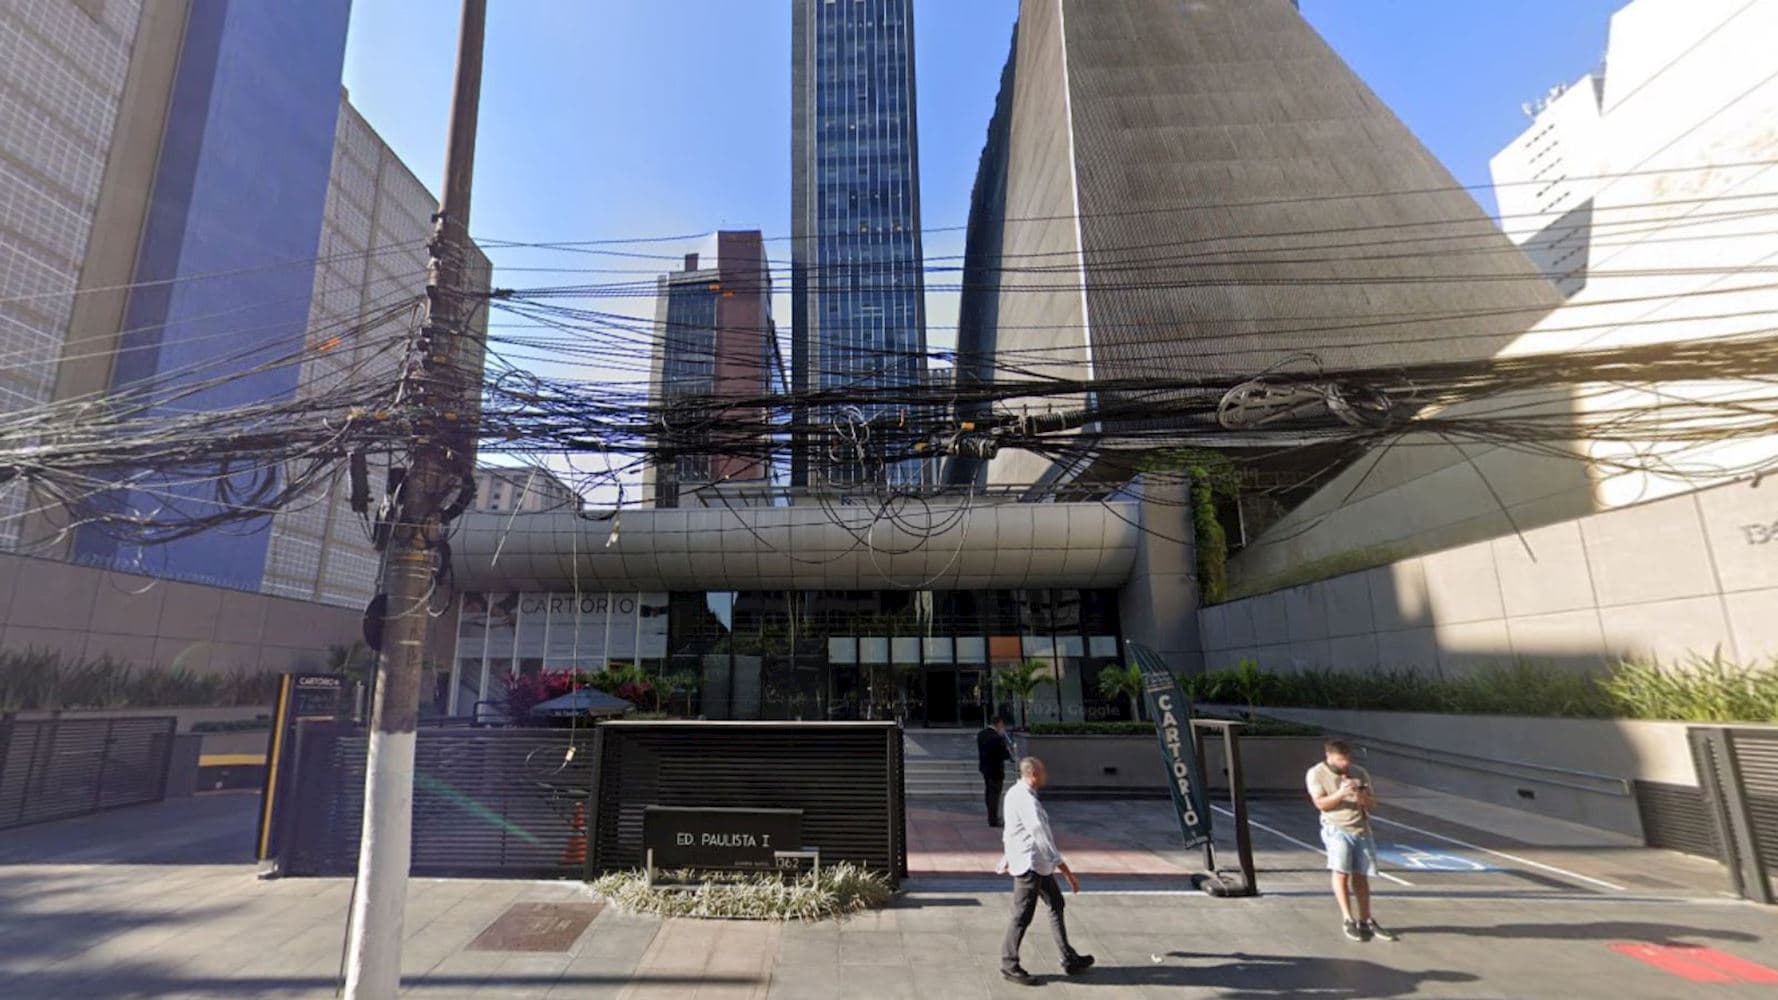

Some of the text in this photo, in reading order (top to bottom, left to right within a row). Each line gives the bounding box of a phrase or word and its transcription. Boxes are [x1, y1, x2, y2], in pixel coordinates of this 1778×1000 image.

[1158, 694, 1199, 827] CARTÓRIO
[676, 831, 771, 848] ED. PAULISTA I
